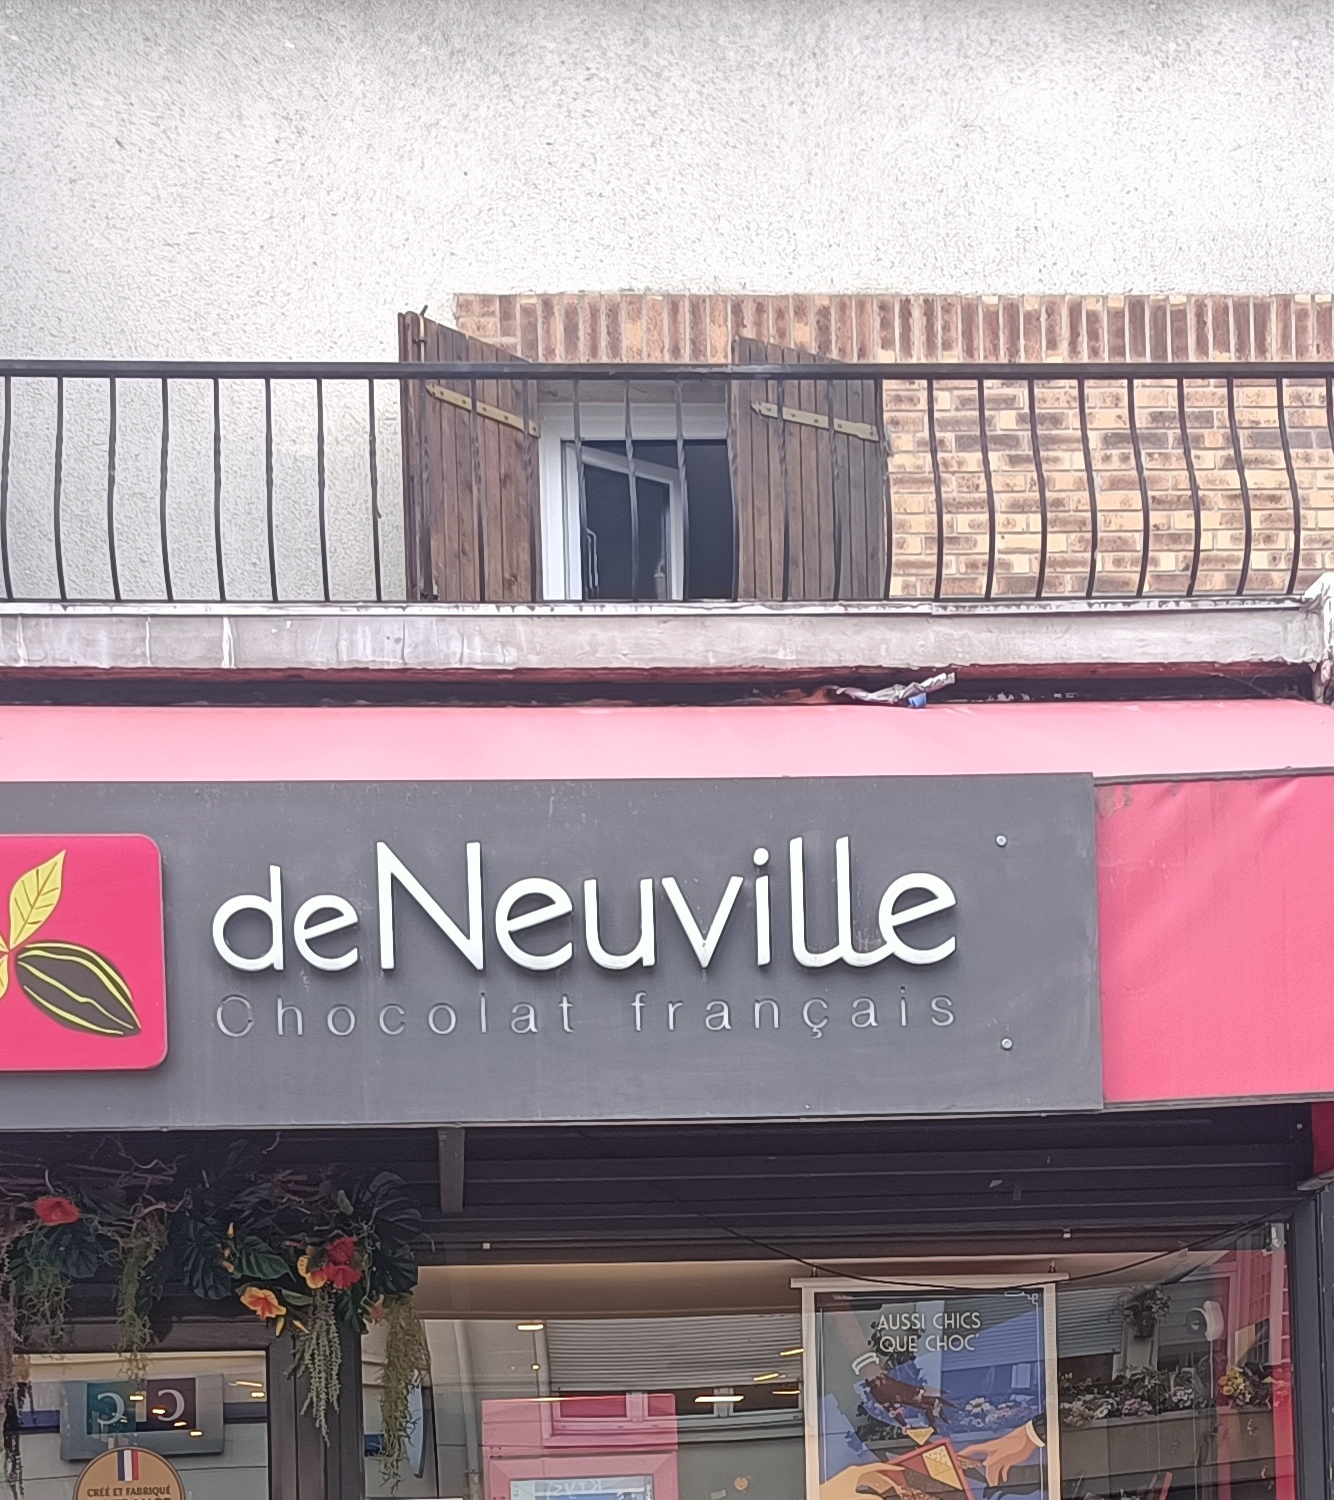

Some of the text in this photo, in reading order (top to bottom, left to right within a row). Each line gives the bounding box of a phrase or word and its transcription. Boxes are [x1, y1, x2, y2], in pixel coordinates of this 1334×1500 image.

[211, 836, 958, 973] deNeuville
[214, 986, 957, 1040] Chocolat français
[877, 1312, 981, 1330] AUSSI CHICS
[879, 1335, 918, 1353] QUE
[86, 1484, 171, 1497] CRÉÉ ET FABRIQUÉ
